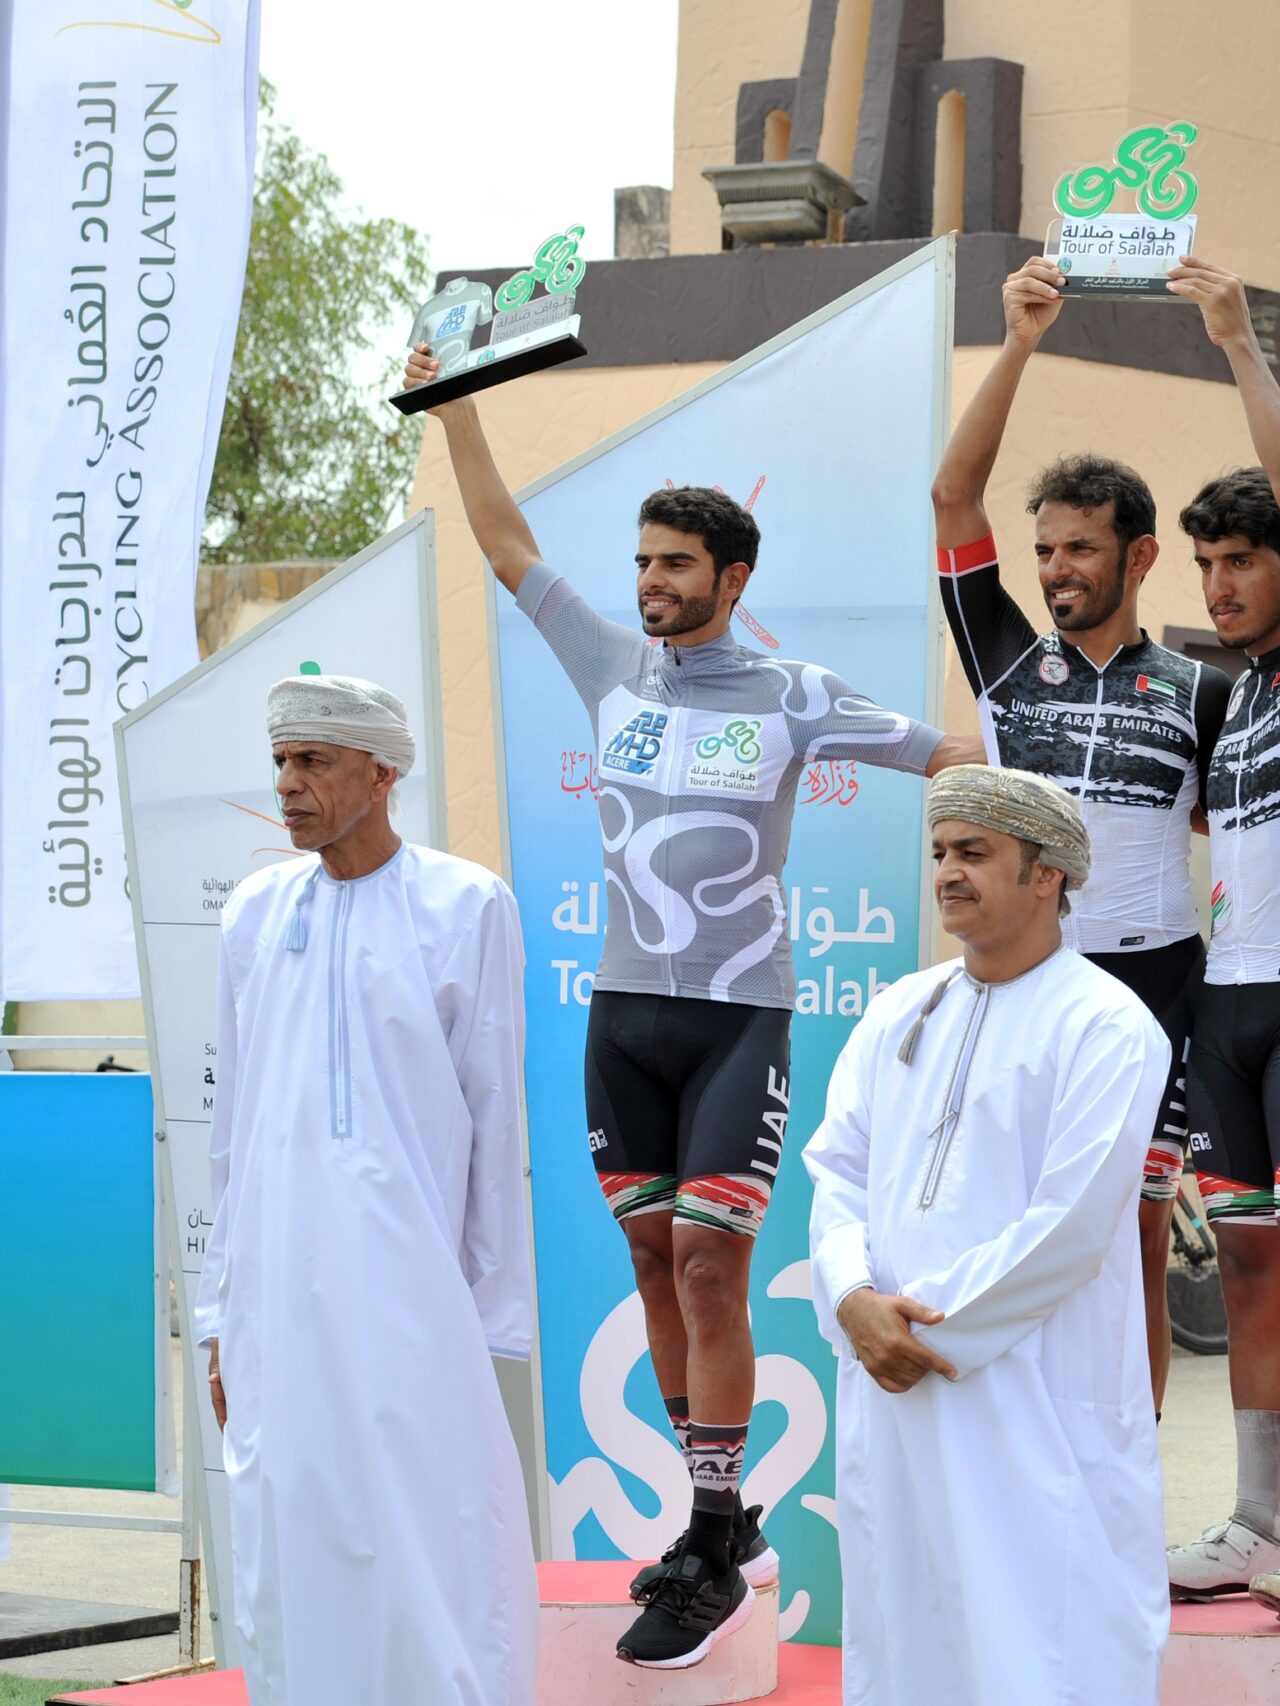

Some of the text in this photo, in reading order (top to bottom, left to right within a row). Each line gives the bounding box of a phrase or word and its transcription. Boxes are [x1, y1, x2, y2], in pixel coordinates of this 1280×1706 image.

[1062, 240, 1175, 256] Tour of Salalah
[495, 309, 573, 343] Tour of Salalah
[113, 82, 178, 712] CYCLING ASSOCIATION
[1012, 698, 1183, 743] UNITED ARAB EMIRATES
[606, 755, 630, 769] ACERE
[1225, 740, 1250, 756] ARAB
[690, 777, 755, 792] Tour of Salalah
[551, 959, 595, 1006] To
[750, 1065, 791, 1176] UAE
